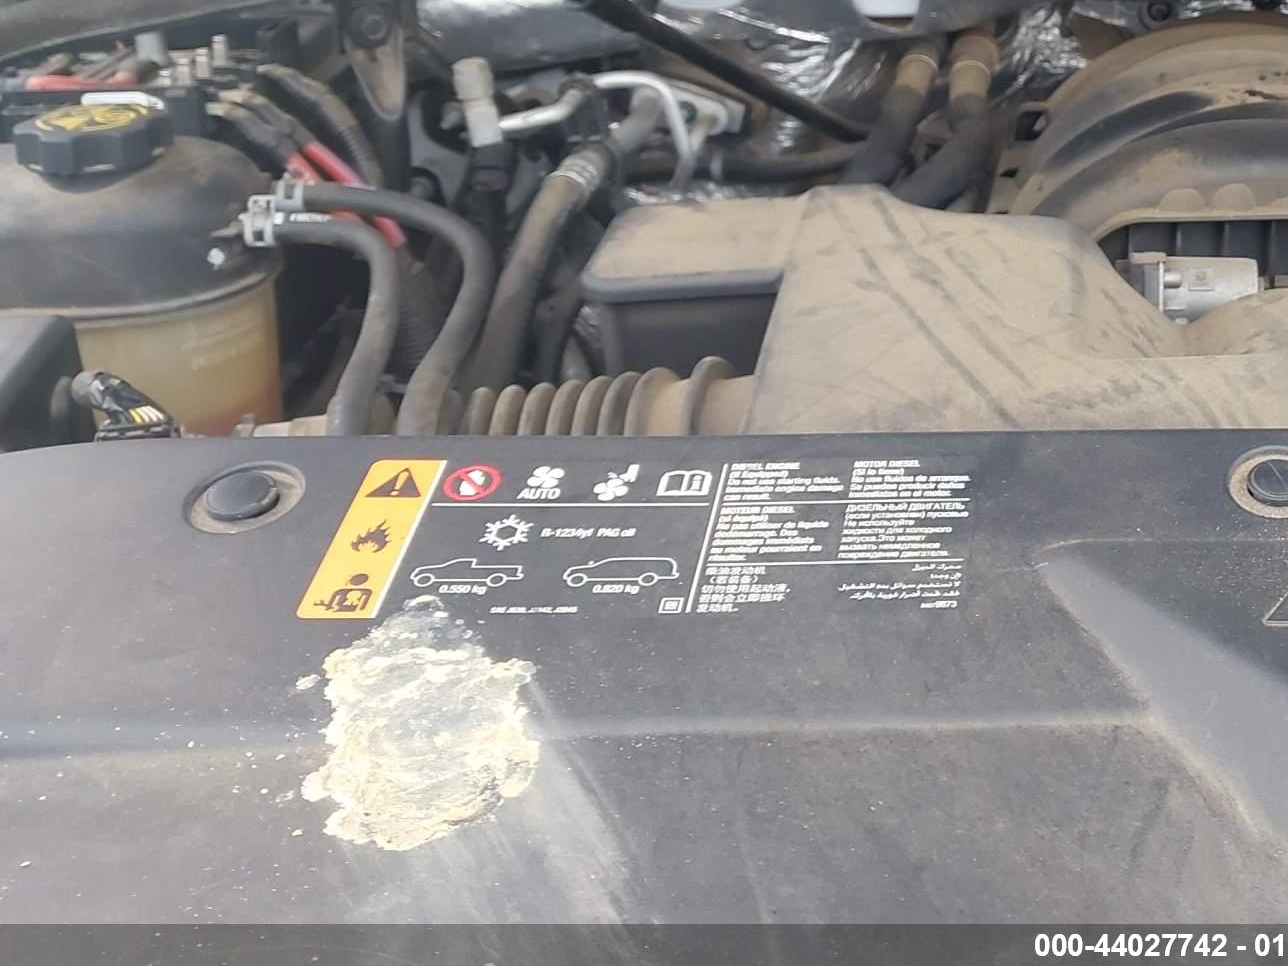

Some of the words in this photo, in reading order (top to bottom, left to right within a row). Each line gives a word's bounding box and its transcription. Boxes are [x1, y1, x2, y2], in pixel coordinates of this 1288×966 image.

[730, 462, 763, 470] DIESEL
[764, 462, 800, 470] ENGINE
[853, 460, 887, 468] MOTOR
[888, 460, 920, 468] DIESEL
[776, 478, 812, 486] starting
[807, 485, 844, 493] damage
[516, 488, 560, 500] AUTO
[762, 506, 795, 514] DIESEL
[908, 502, 965, 512] ДВИГАТЕЛЬ
[540, 528, 594, 539] R-1234yf
[596, 528, 620, 538] PAG
[621, 528, 636, 538] oil
[779, 529, 798, 537] Des
[438, 584, 471, 594] 0.550
[471, 584, 488, 595] kg
[592, 584, 622, 594] 0.820
[622, 584, 640, 595] kg
